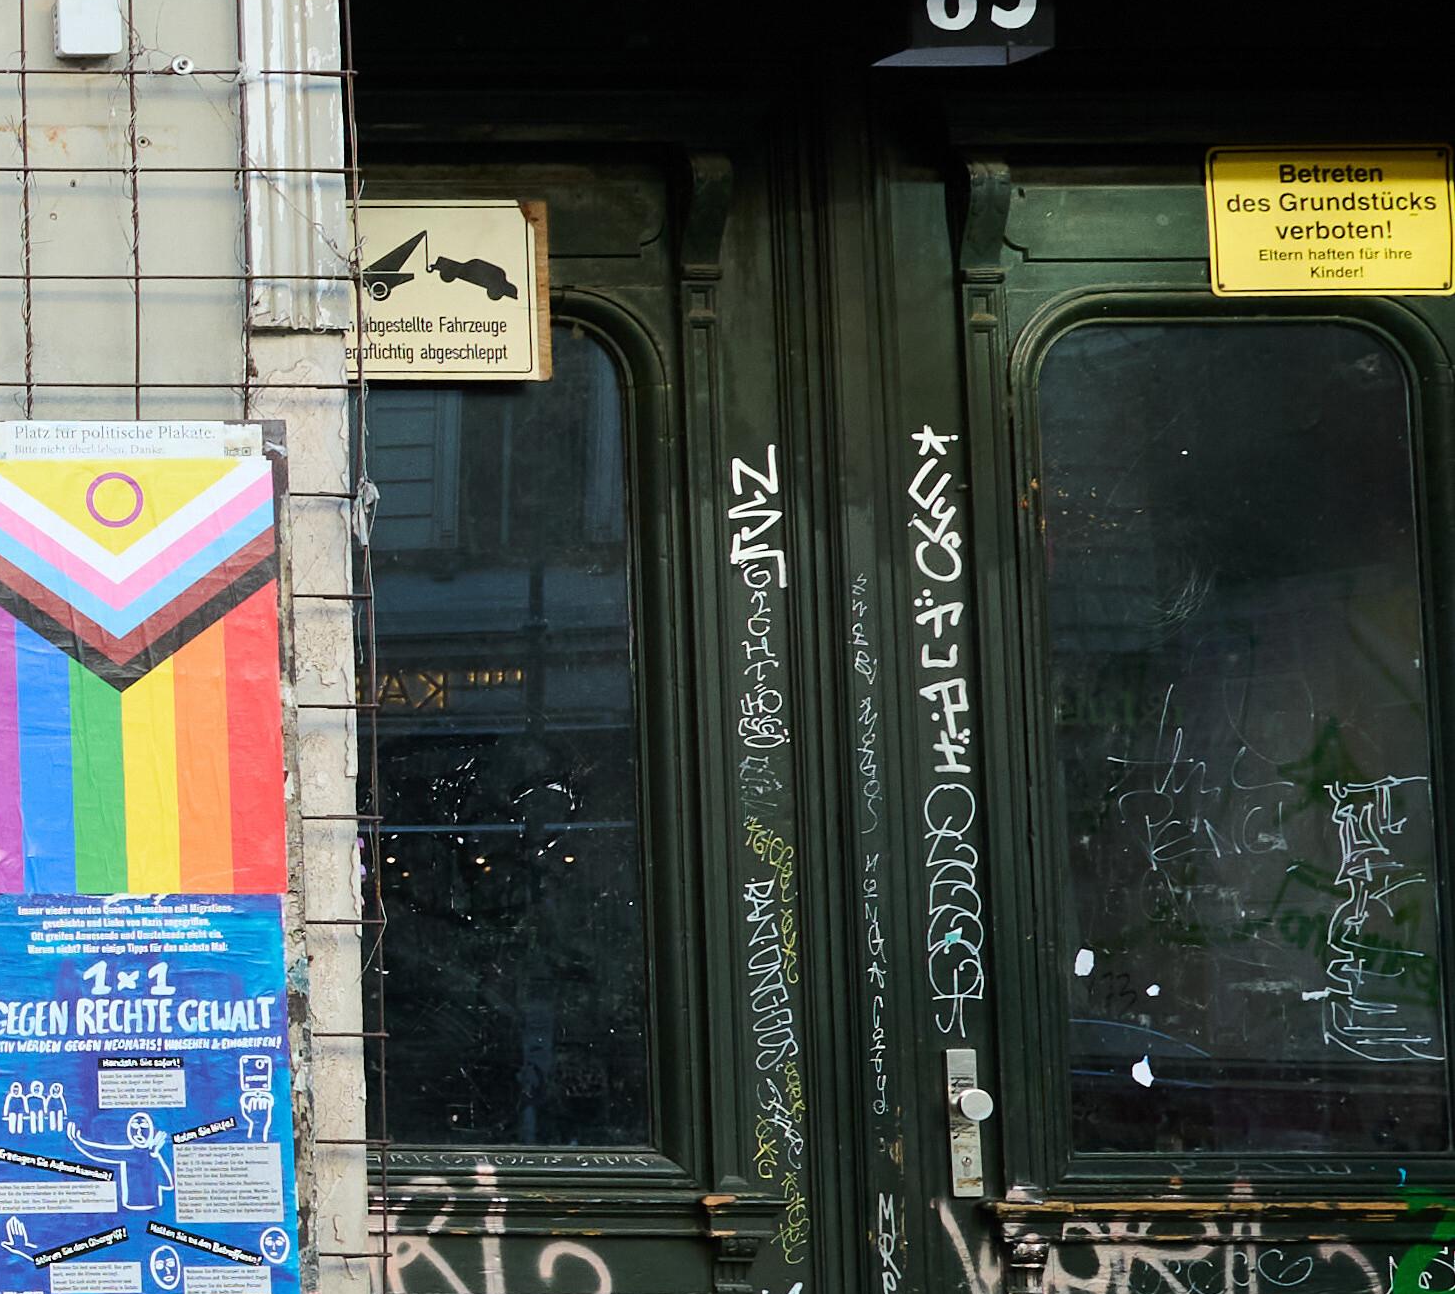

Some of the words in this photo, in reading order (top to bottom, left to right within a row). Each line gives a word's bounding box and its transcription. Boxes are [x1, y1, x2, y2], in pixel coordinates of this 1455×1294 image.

[1279, 165, 1383, 183] Betreten
[1227, 195, 1271, 212] des
[1279, 192, 1437, 211] Grundstücks
[1276, 221, 1392, 239] verboten!
[1259, 250, 1302, 261] Eltern
[1309, 249, 1354, 260] haften
[1359, 249, 1379, 260] für
[1384, 249, 1412, 259] ihre
[1310, 267, 1364, 278] Kinder!
[439, 317, 506, 336] Fahrzeuge
[421, 345, 508, 364] abgeschleppt
[15, 425, 50, 440] Platz
[82, 425, 153, 442] politische
[158, 425, 216, 439] Plakate.
[76, 998, 173, 1035] RECHTE
[178, 995, 276, 1033] GEWALT
